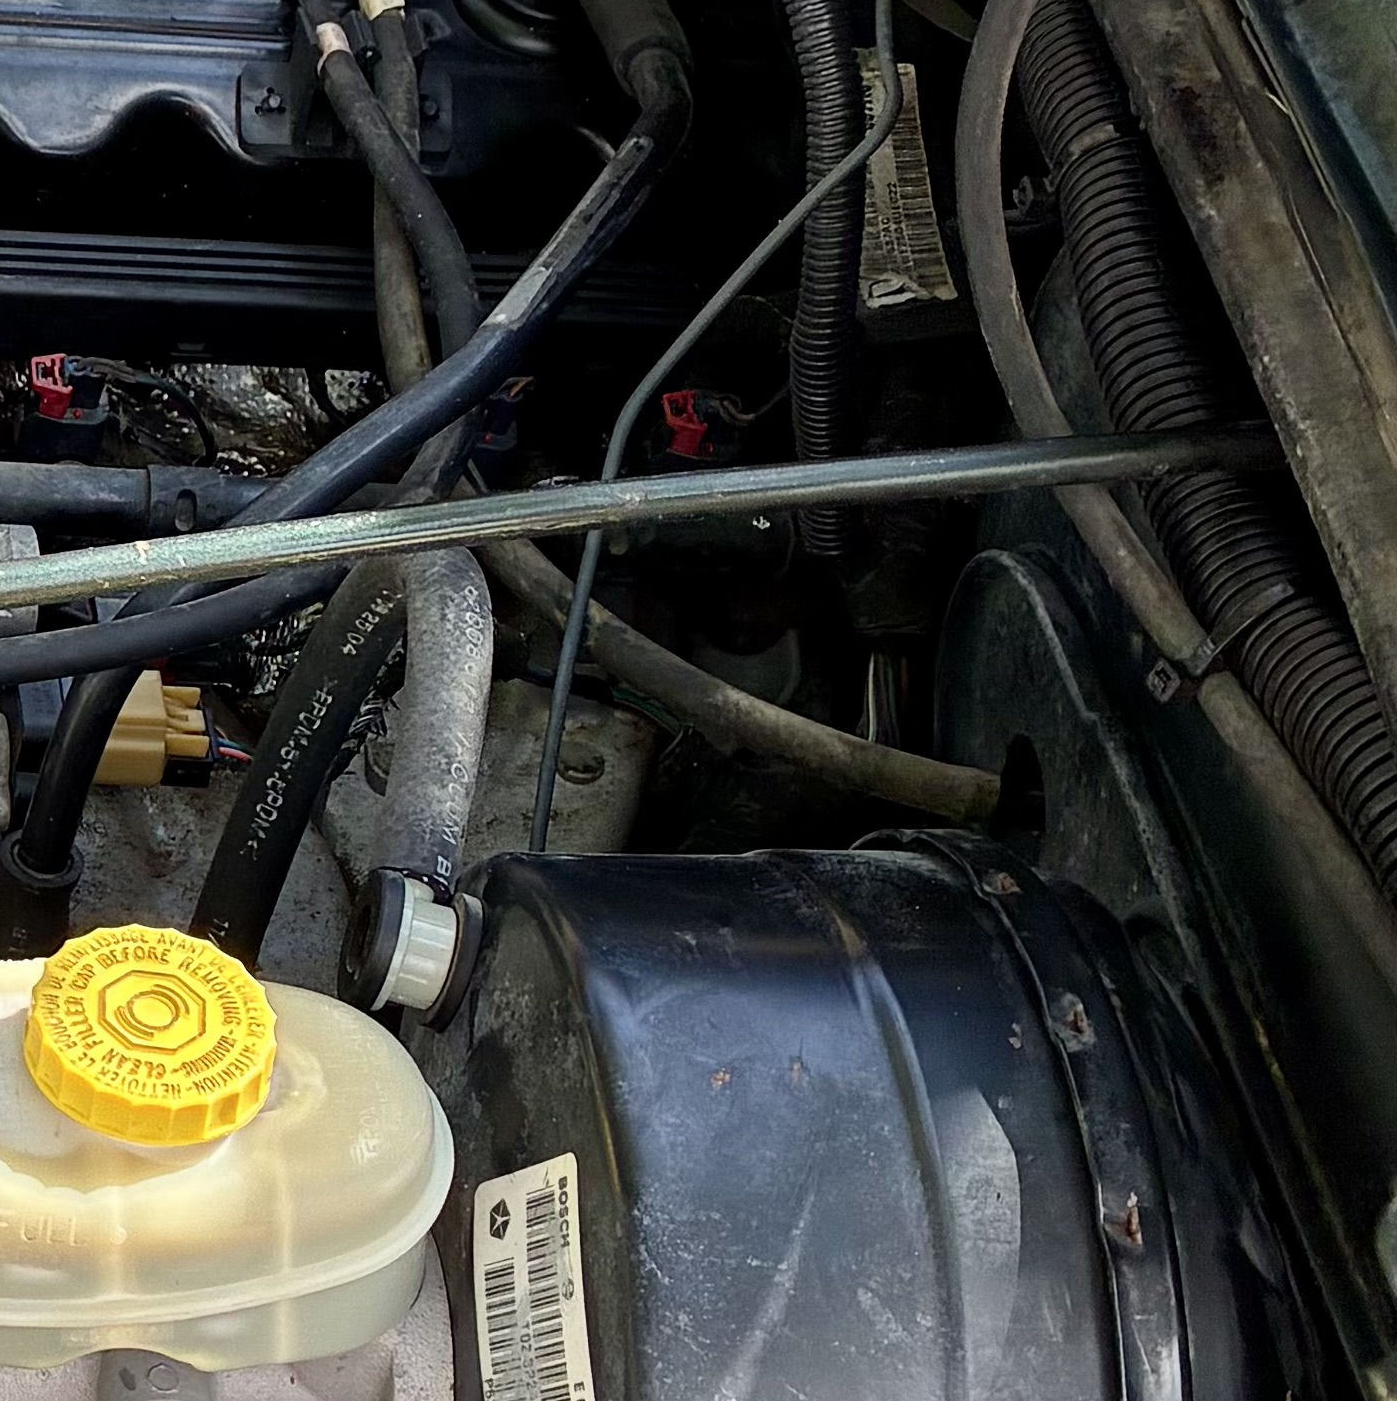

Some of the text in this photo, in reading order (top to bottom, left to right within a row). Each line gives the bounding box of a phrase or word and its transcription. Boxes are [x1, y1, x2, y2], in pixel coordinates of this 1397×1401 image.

[69, 963, 97, 991] CAP
[97, 945, 172, 969] BEFORE
[41, 993, 78, 1053] BOUCHON
[156, 932, 207, 958] AVANT
[178, 956, 242, 1028] REMOVING
[63, 996, 104, 1050] FILLER
[102, 1048, 167, 1080] CLEAN
[558, 1175, 571, 1249] BOSCH
[573, 1381, 585, 1392] E
